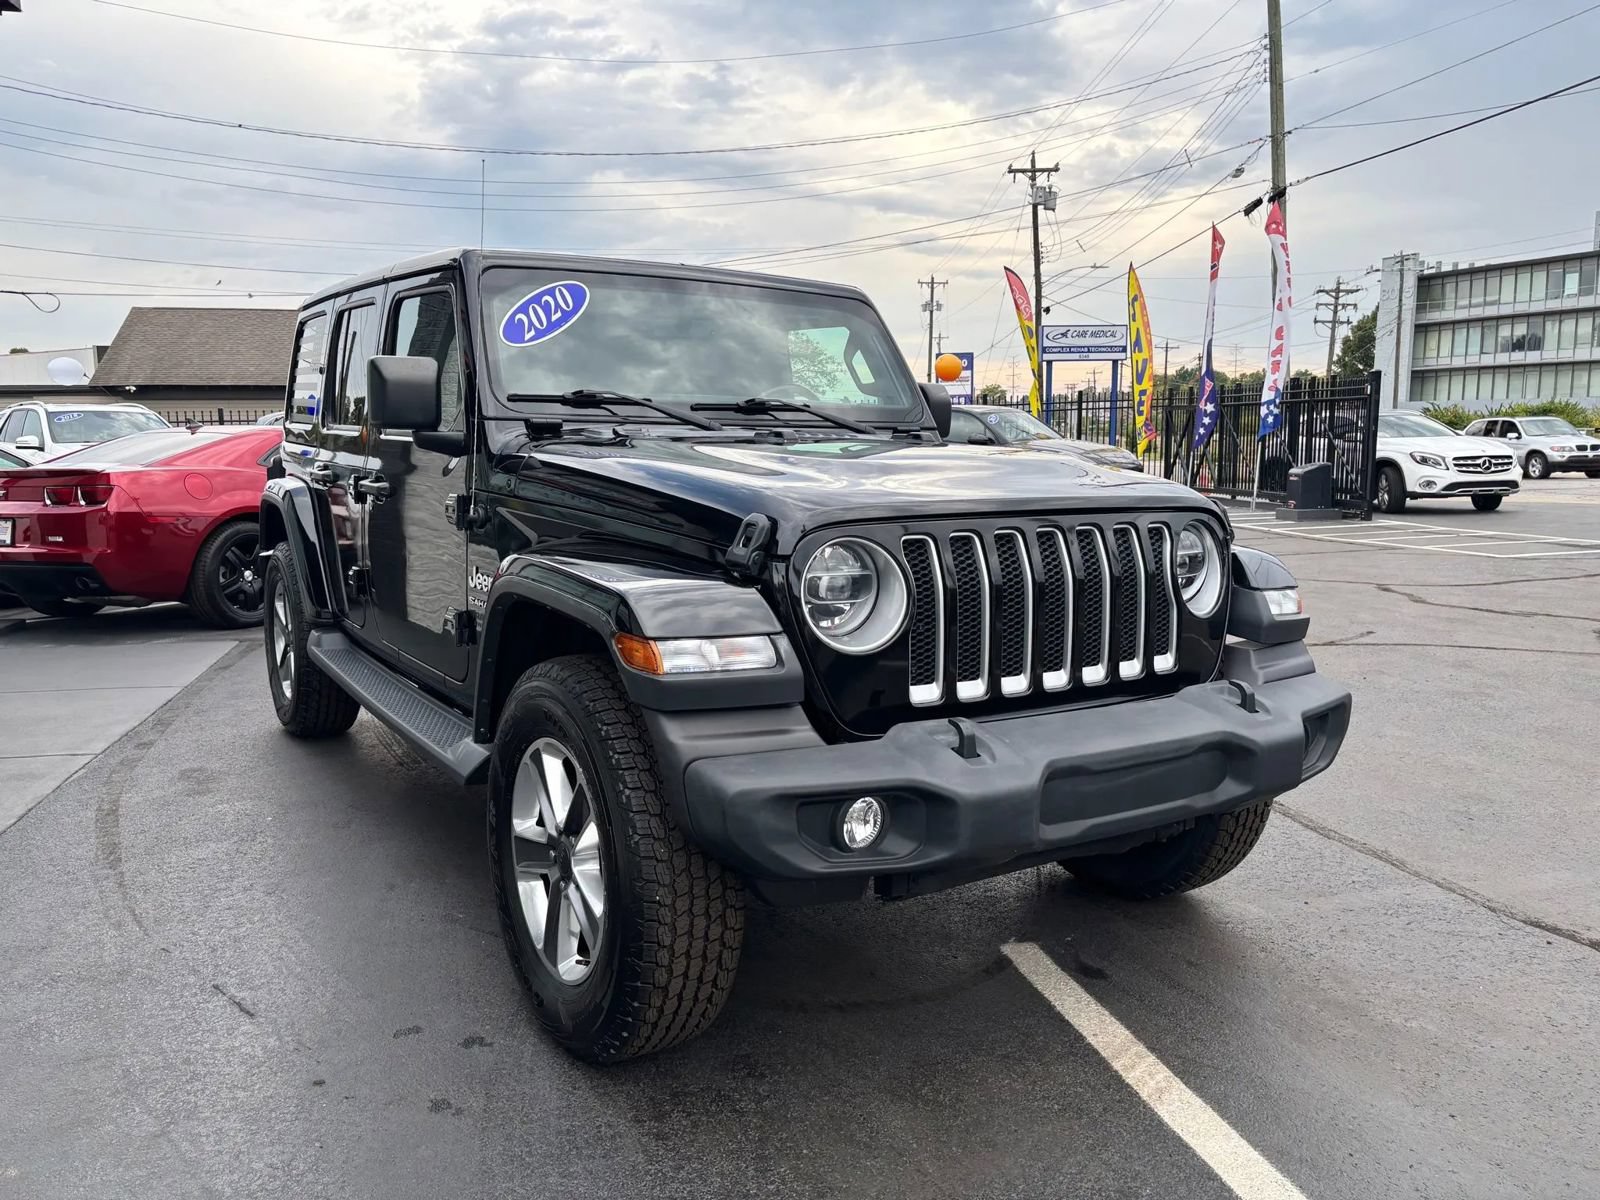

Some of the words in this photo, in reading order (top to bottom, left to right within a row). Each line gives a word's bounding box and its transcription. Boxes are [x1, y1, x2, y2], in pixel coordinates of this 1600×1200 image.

[515, 286, 574, 342] 2020
[1070, 329, 1090, 339] CARE
[1088, 329, 1118, 339] MEDICAL
